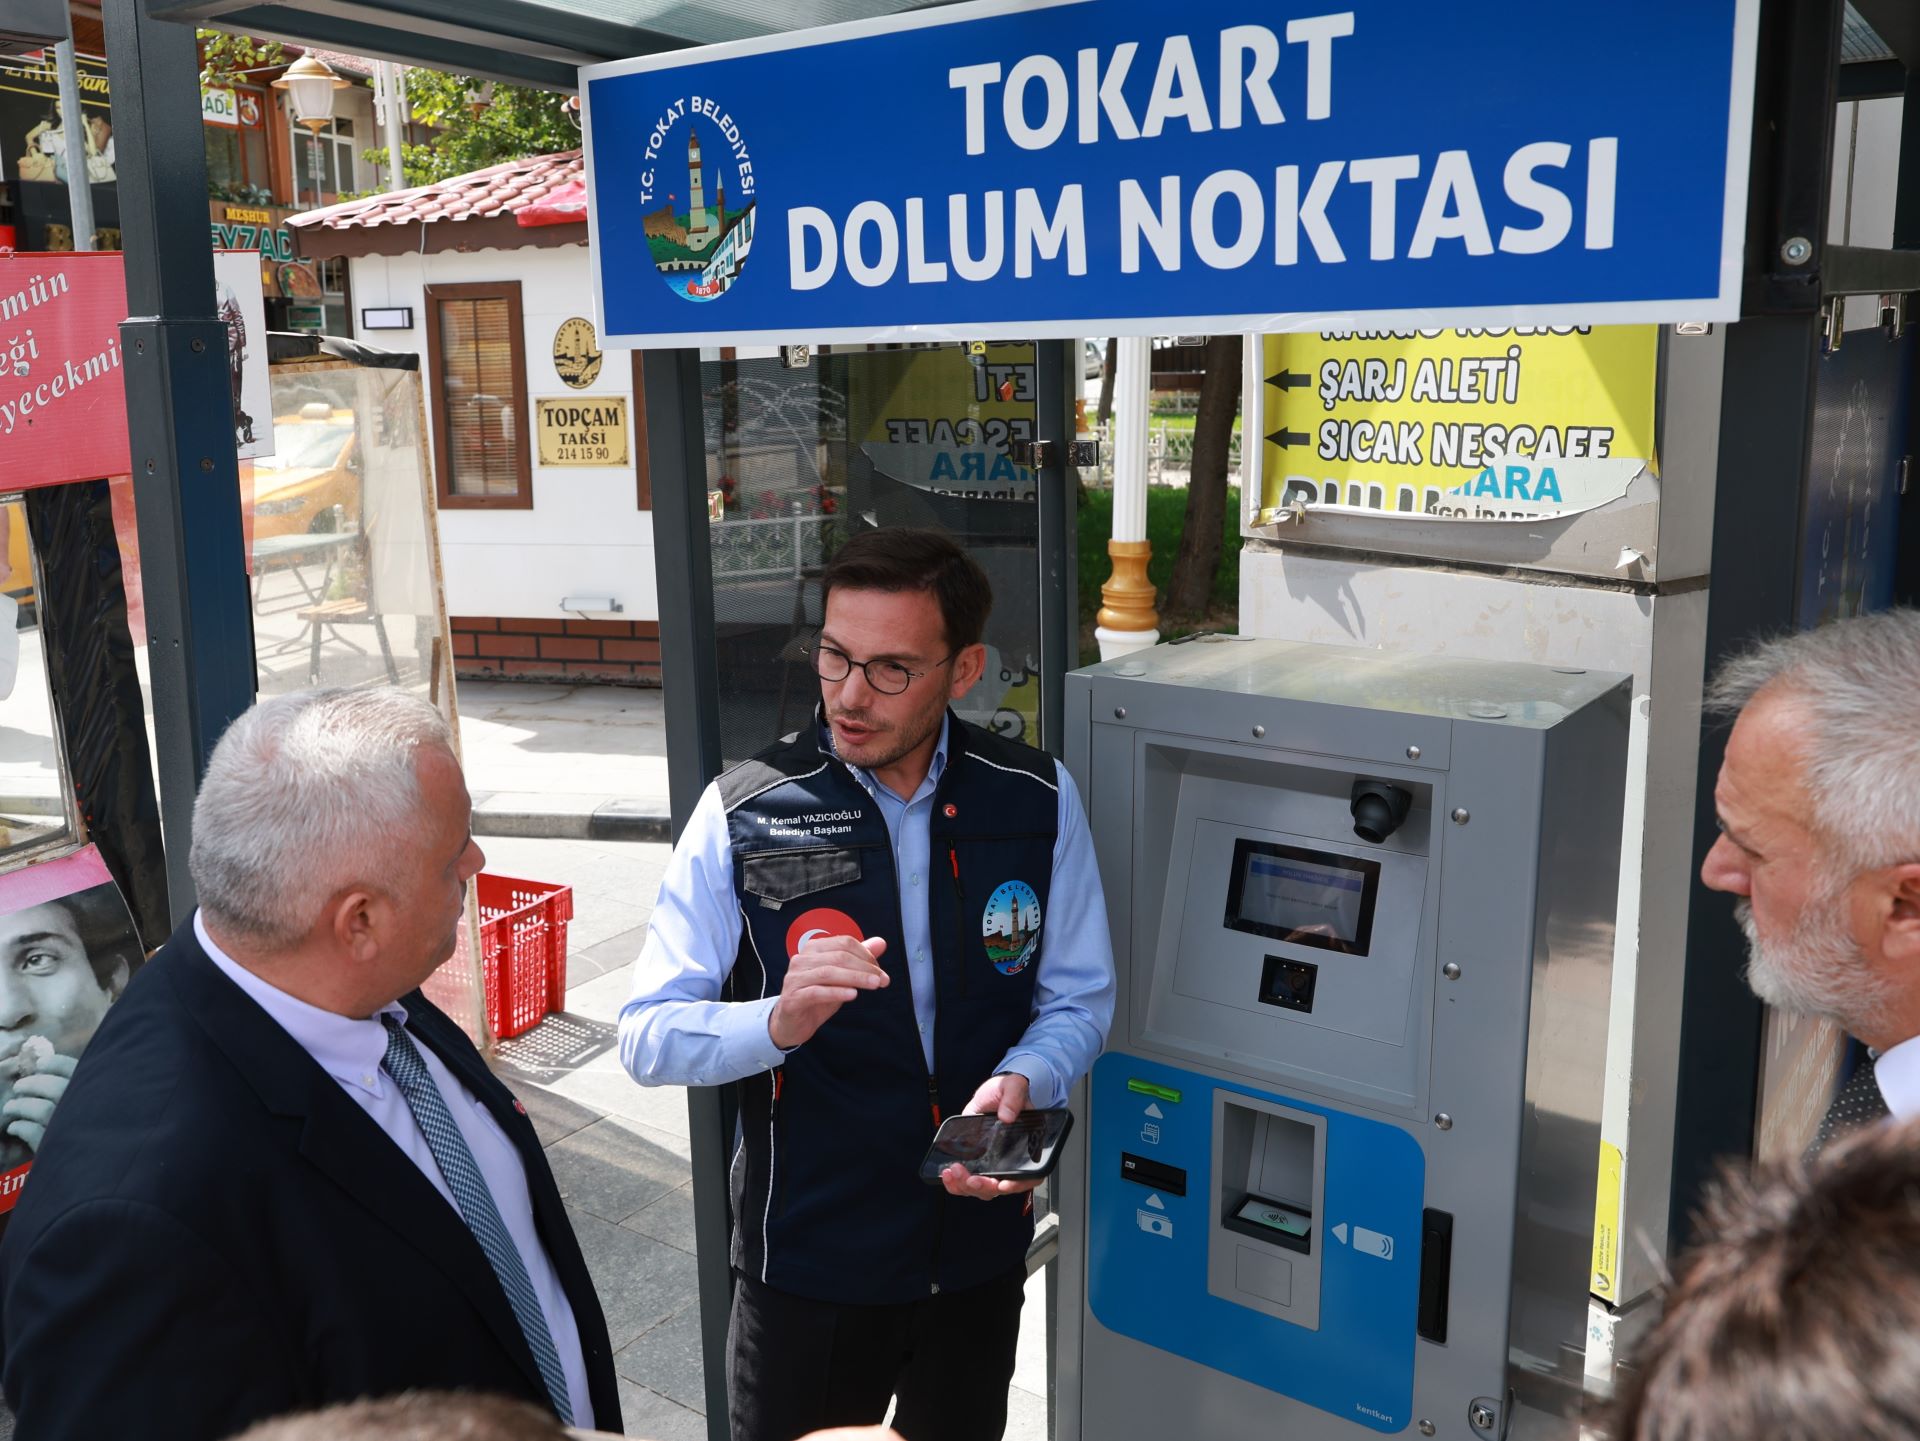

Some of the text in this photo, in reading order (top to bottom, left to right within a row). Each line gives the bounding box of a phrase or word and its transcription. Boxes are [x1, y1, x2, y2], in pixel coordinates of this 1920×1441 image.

[949, 12, 1354, 155] TOKART
[645, 98, 685, 161] TOKAT
[641, 167, 655, 205] T.C.
[787, 137, 1618, 290] DOLUM NOKTASI
[0, 272, 69, 321] mün
[695, 286, 711, 295] 1870
[0, 338, 122, 434] yecekmi
[1319, 344, 1522, 411] ŞARJ ALETİ
[544, 407, 620, 432] TOPÇAM
[559, 428, 606, 445] TAKSİ
[557, 447, 609, 460] 214 15 90
[1317, 418, 1424, 465] SICAK
[757, 810, 862, 825] M. Kemal YAZICIOĞLU
[769, 825, 852, 837] Belediye Başkanı
[1356, 1402, 1393, 1424] kentkart
